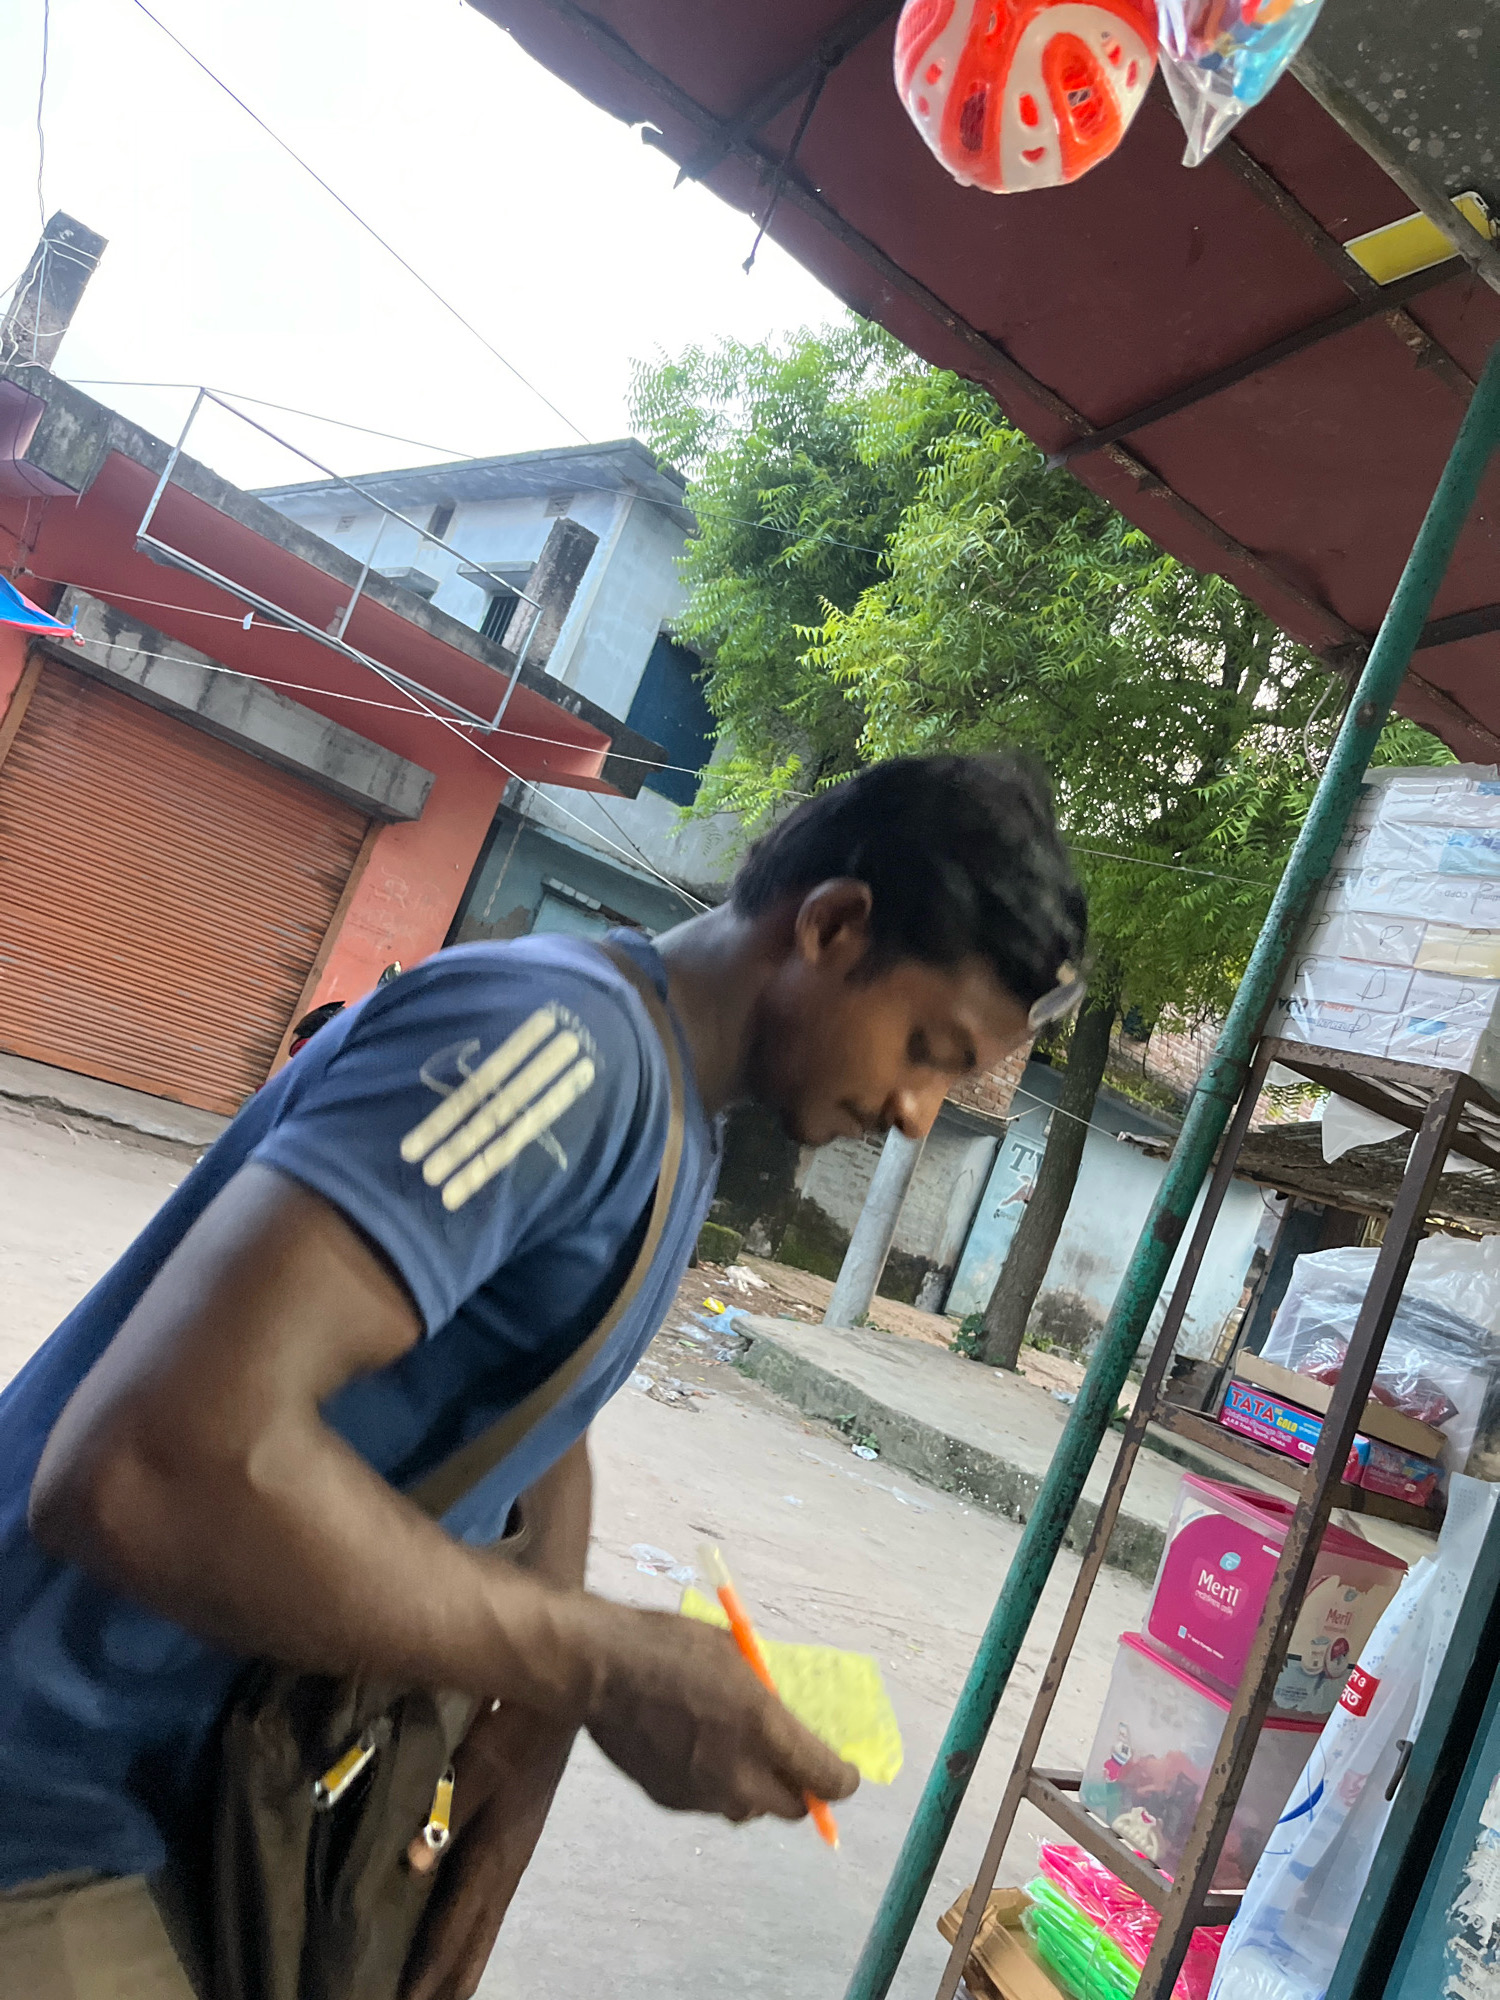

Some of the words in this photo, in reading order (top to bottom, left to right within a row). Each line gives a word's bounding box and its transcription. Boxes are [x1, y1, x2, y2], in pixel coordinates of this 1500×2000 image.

[1231, 1388, 1275, 1423] TATA
[1276, 1416, 1298, 1433] GOLD
[1198, 1569, 1240, 1607] Meril
[1325, 1608, 1354, 1626] Meril
